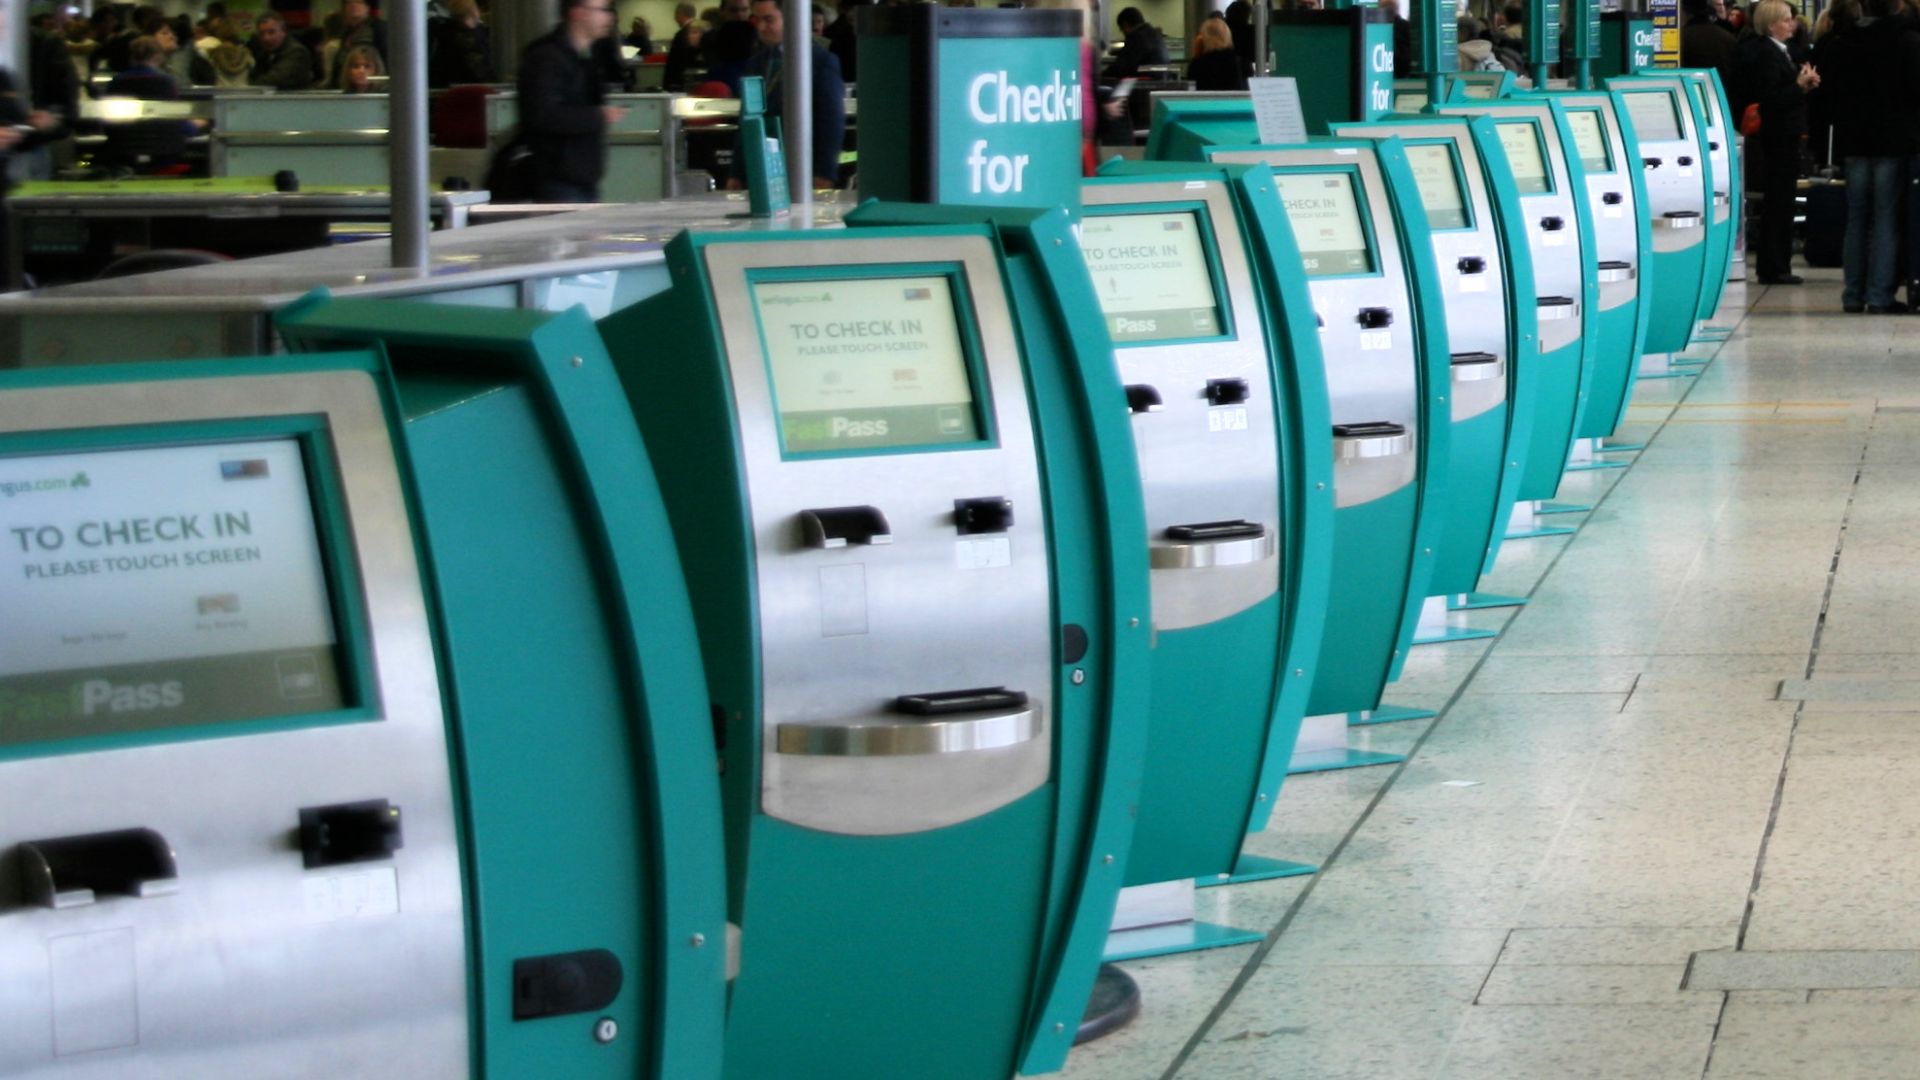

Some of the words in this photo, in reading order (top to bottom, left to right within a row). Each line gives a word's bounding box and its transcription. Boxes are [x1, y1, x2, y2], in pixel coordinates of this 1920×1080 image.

[1635, 50, 1648, 66] for
[1372, 80, 1389, 111] for
[968, 140, 1029, 194] for
[1084, 248, 1104, 260] TO
[1108, 245, 1158, 259] CHECK
[1162, 244, 1178, 256] IN
[790, 323, 819, 340] TO
[824, 320, 895, 338] CHECK
[901, 319, 923, 335] IN
[797, 344, 840, 356] PLEASE
[840, 342, 881, 353] TOUCH
[884, 340, 929, 352] SCREEN
[11, 525, 63, 552] TO
[77, 515, 203, 548] CHECK
[215, 511, 252, 536] IN
[24, 558, 101, 579] PLEASE
[104, 554, 178, 573] TOUCH
[184, 546, 261, 566] SCREEN
